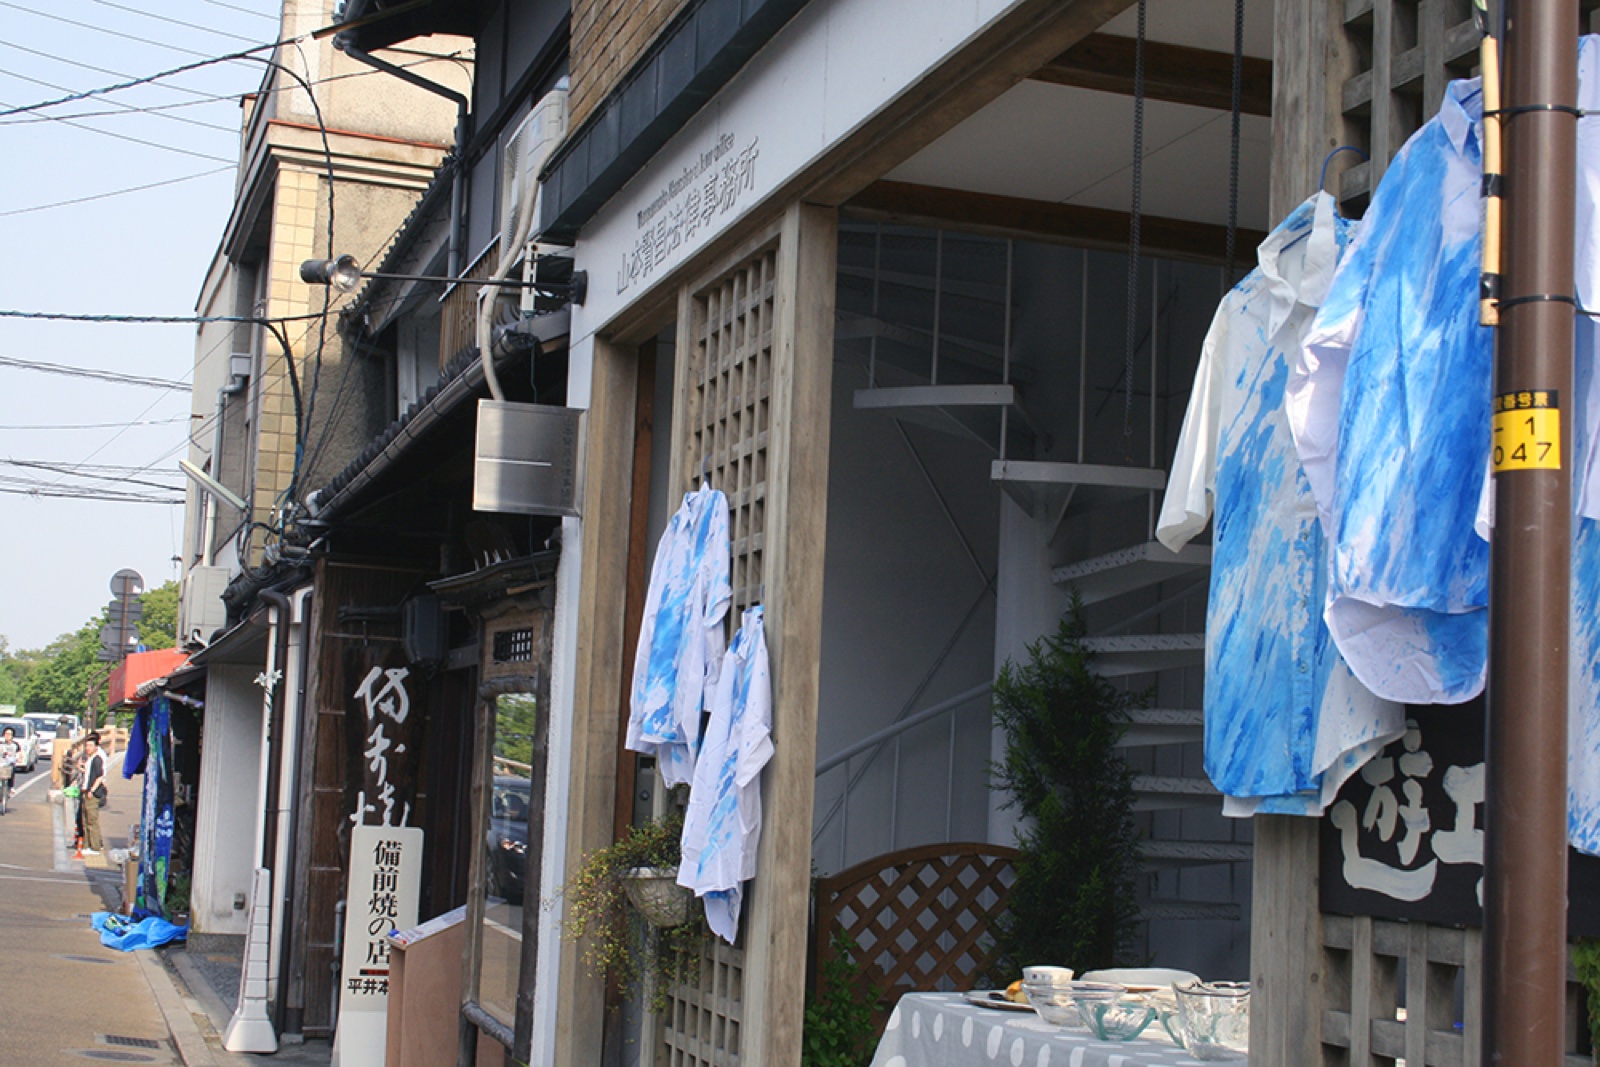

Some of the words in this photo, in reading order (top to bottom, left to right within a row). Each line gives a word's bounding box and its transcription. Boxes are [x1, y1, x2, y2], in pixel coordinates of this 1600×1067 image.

[1494, 442, 1552, 466] 047
[366, 839, 402, 966] 備前焼の店
